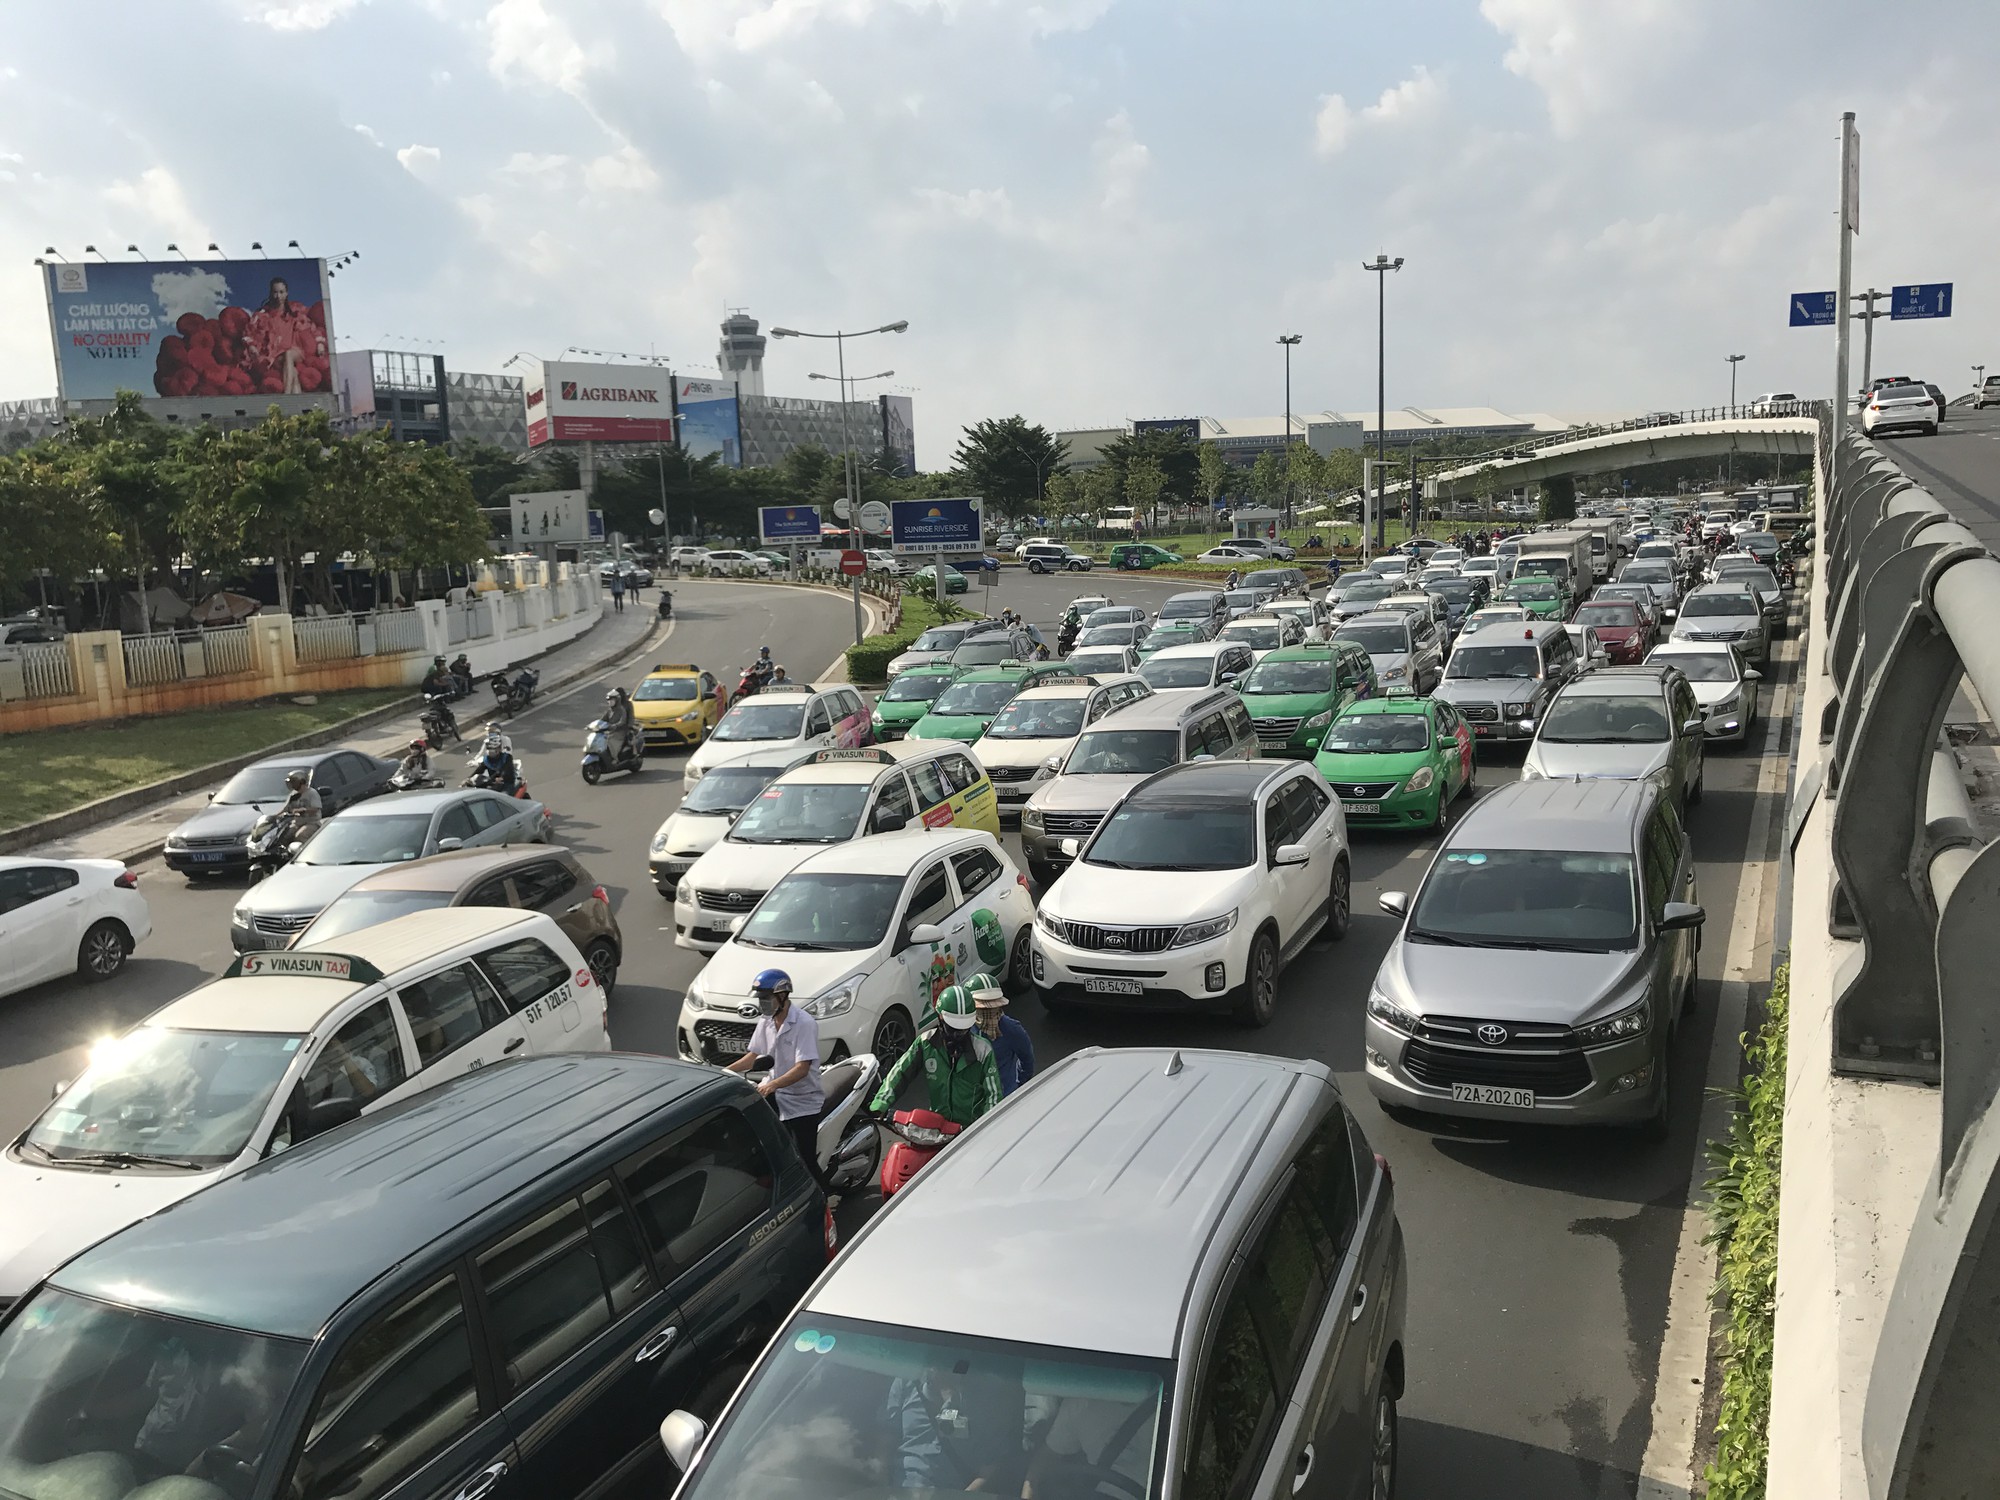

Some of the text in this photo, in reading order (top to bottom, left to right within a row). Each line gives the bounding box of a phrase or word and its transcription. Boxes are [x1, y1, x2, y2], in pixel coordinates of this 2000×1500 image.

[73, 332, 151, 346] NO QUALITY
[86, 346, 142, 359] NO LIFE
[580, 387, 659, 403] AGRIBANK
[904, 523, 969, 533] SUNRISE RIVERSIDE
[974, 924, 989, 941] fuze
[270, 958, 350, 975] VINASUN TAXI
[525, 984, 573, 1024] 51F 120.57
[1454, 1085, 1532, 1107] 72A-202.06
[749, 1204, 795, 1247] 4500 EFI
